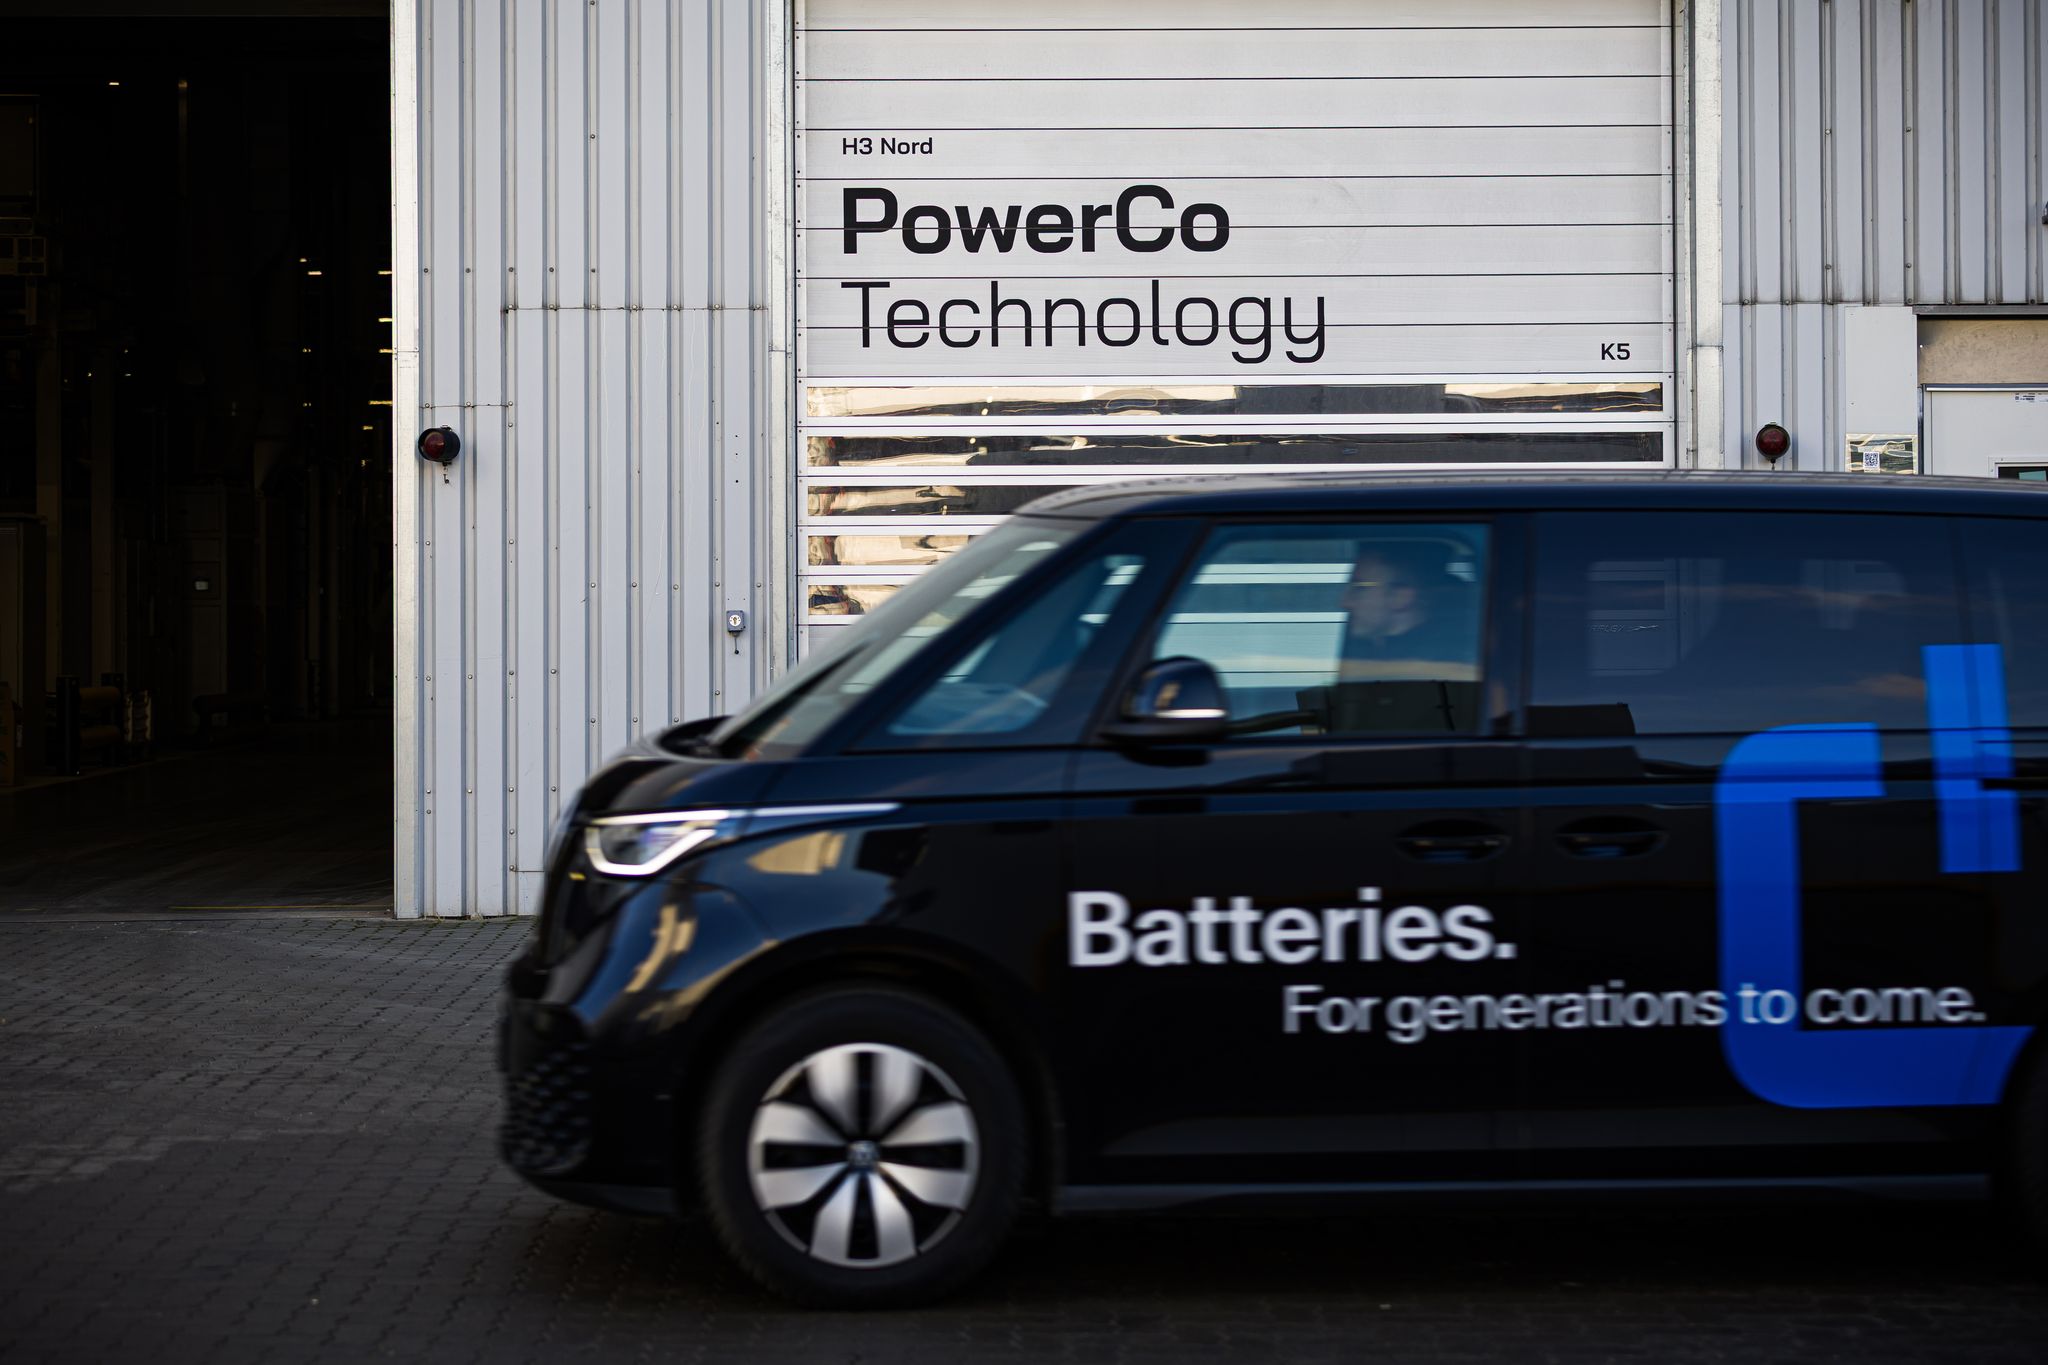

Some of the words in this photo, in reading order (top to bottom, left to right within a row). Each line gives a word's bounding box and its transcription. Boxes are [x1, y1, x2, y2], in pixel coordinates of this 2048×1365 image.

[842, 137, 873, 155] H3
[880, 137, 933, 155] Nord
[842, 184, 1230, 255] PowerCo
[841, 280, 1326, 364] Technology
[1601, 343, 1631, 361] K5
[1069, 886, 1517, 967] Batteries.
[1283, 984, 1381, 1034] For
[1385, 980, 1728, 1044] generations
[1737, 983, 1796, 1025] to
[1805, 986, 1986, 1024] come.
